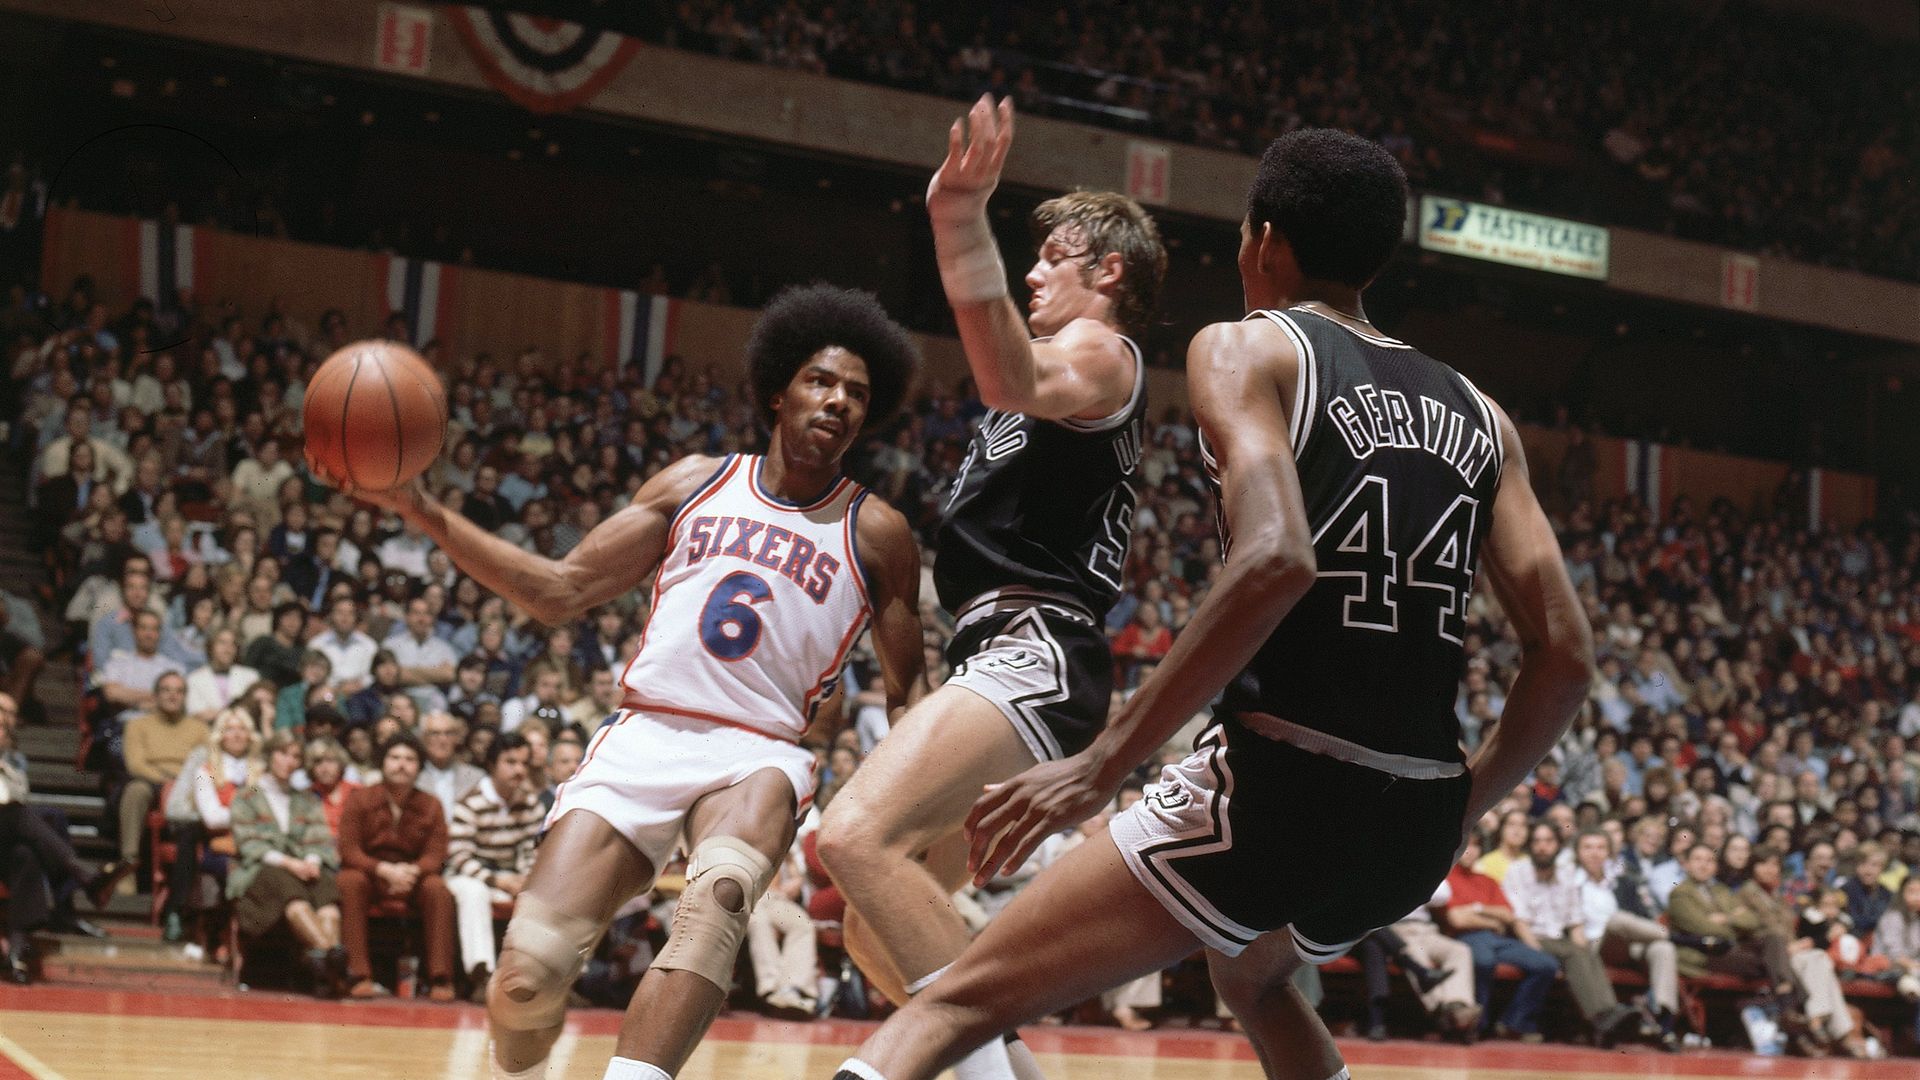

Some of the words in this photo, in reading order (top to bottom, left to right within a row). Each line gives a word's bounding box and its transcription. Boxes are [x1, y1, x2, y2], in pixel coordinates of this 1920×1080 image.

[1327, 383, 1495, 489] GERVIN
[686, 516, 841, 605] SIXERS
[1312, 475, 1480, 647] 44
[698, 570, 775, 662] 6
